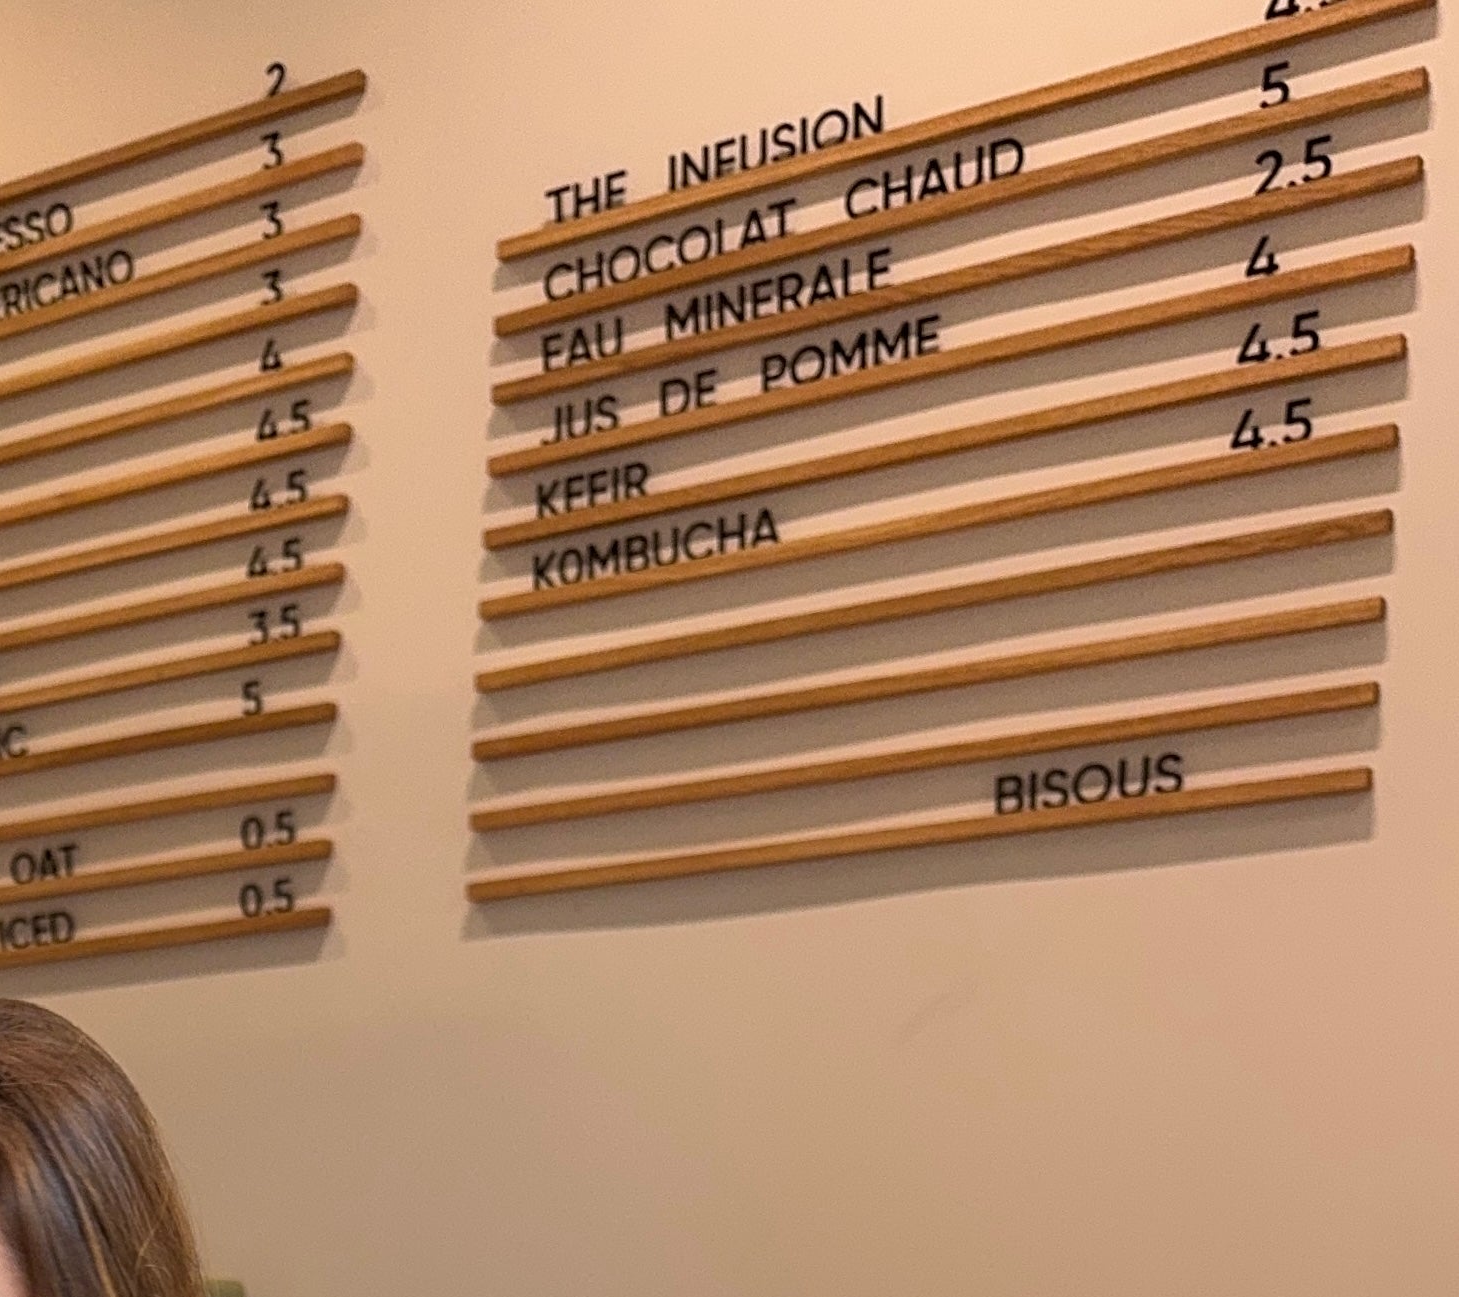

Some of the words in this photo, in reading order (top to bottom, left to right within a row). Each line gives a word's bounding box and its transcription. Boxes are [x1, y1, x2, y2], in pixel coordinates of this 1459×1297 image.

[266, 63, 286, 97] 2
[261, 131, 282, 169] 3
[545, 168, 630, 226] THE
[666, 95, 887, 193] INFUSION
[541, 198, 798, 304] CHOCOLAT
[842, 137, 1027, 221] CHAUD
[1258, 61, 1290, 108] 5
[261, 201, 283, 239] 3
[541, 316, 626, 372] EAU
[663, 248, 895, 340] MINERALE
[1254, 134, 1333, 196] 2.5
[260, 269, 283, 305] 3
[260, 339, 282, 372] 4
[540, 396, 622, 447] JUS
[658, 371, 719, 417] DE
[760, 315, 942, 394] POMME
[1245, 235, 1279, 278] 4
[1237, 310, 1321, 366] 4.5
[257, 399, 310, 441] 4.5
[248, 469, 309, 512] 4.5
[532, 508, 781, 592] KOMBUCHA
[1230, 397, 1313, 449] 4.5
[246, 537, 304, 579] 4.5
[247, 604, 303, 645] 3.5
[240, 680, 264, 718] 5
[992, 752, 1186, 818] BISOUS
[8, 843, 81, 885] OAT
[239, 811, 297, 851] 0.5
[238, 878, 295, 919] 0.5
